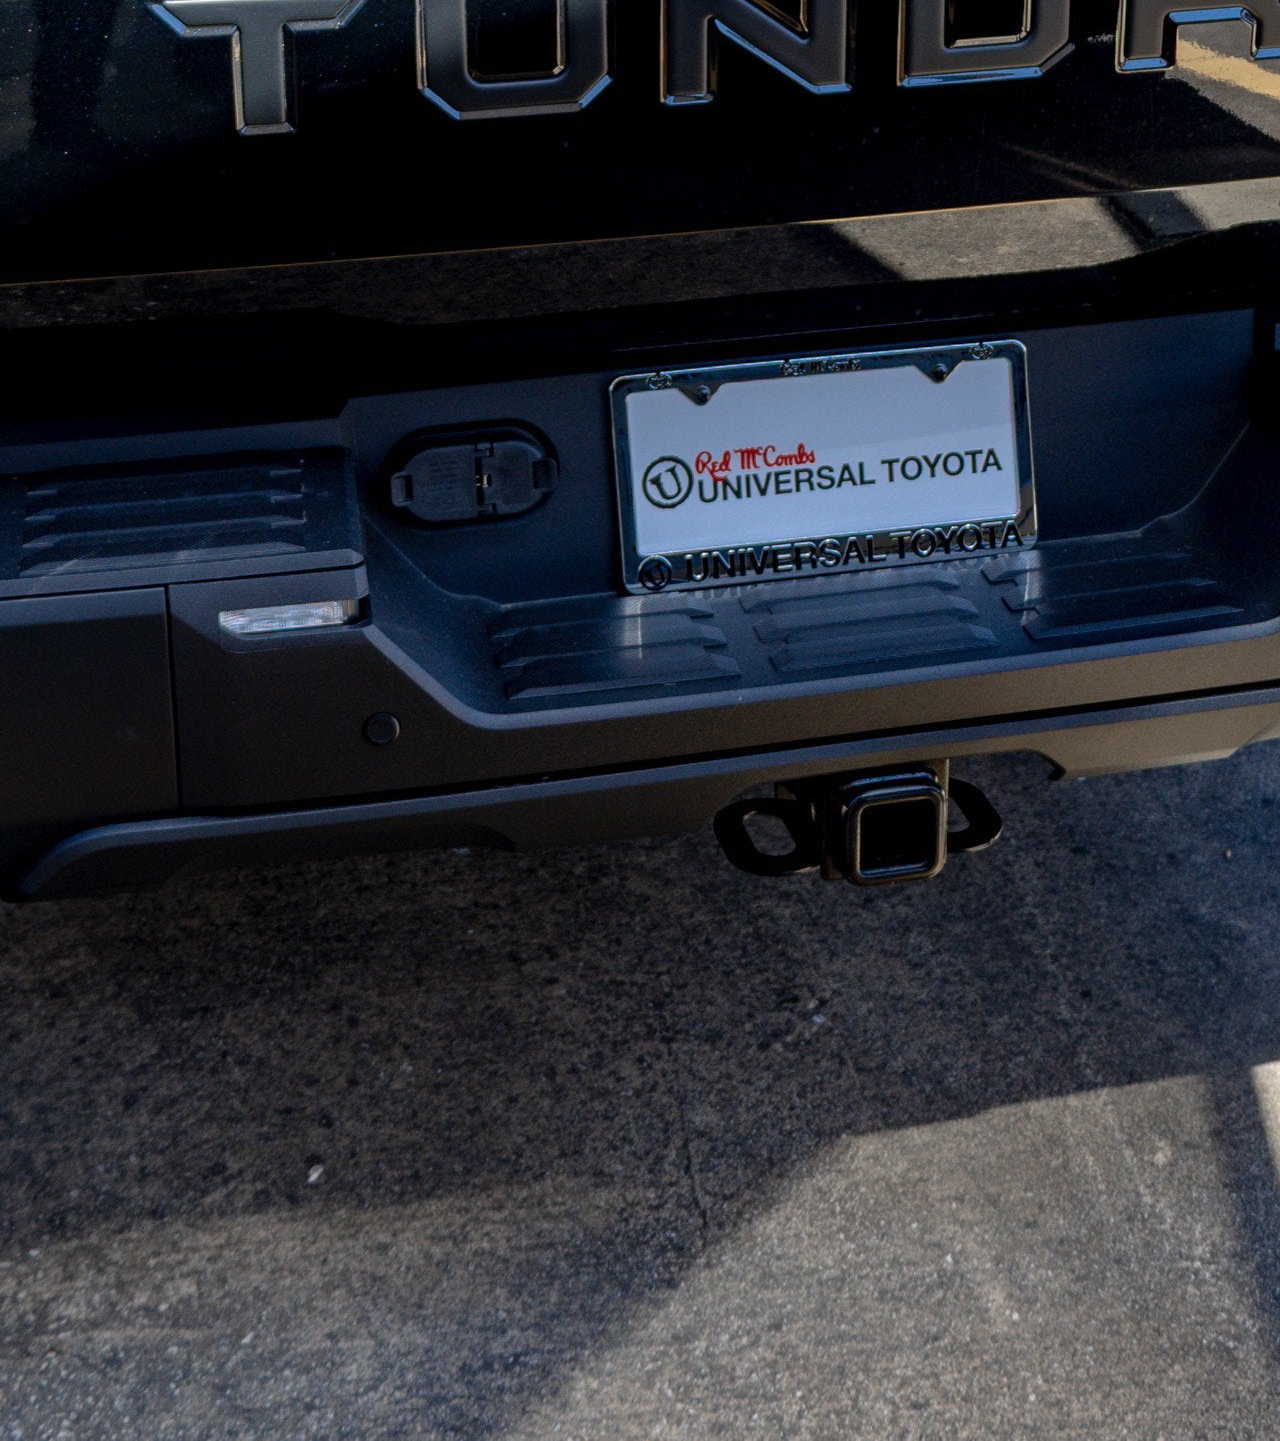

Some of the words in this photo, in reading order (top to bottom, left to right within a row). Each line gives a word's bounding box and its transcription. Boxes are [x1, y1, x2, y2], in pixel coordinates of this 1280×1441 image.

[695, 450, 731, 482] Red
[733, 442, 816, 470] McCombs
[698, 461, 876, 503] UNIVERSAL
[880, 448, 1002, 482] TOYOTA
[685, 535, 887, 582] UNIVERSAL
[889, 519, 1024, 559] TOYOTA
